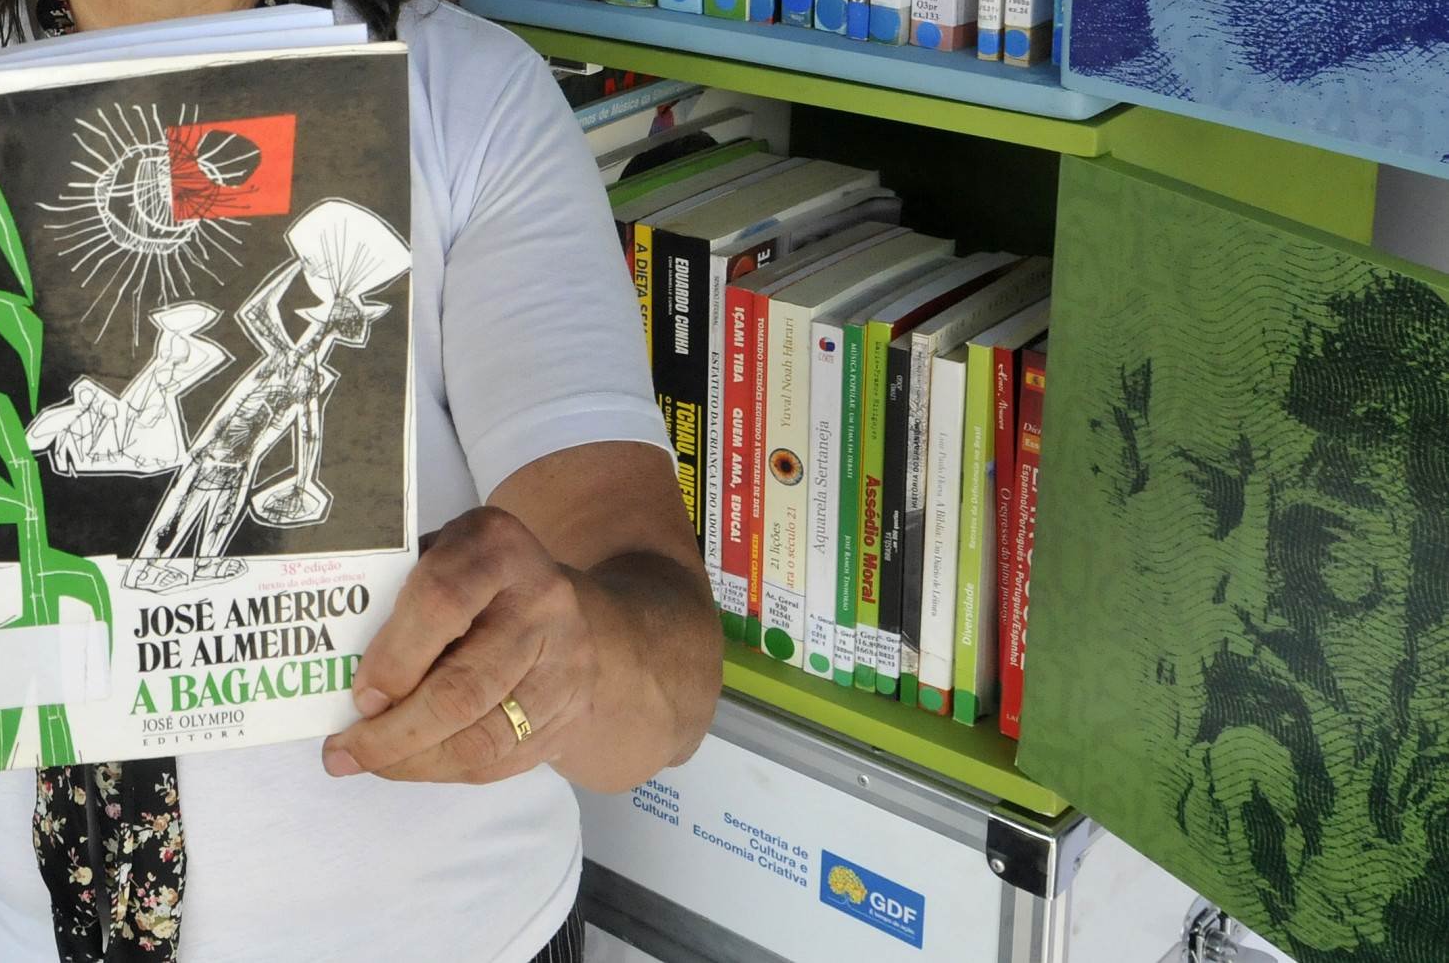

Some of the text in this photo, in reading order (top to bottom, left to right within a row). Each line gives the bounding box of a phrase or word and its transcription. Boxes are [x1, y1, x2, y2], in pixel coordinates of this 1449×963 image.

[635, 242, 648, 299] A DIETA
[674, 257, 690, 355] EDUARDO CUNHA
[755, 318, 764, 360] TOMANDO
[710, 351, 720, 410] ESTATUTO
[781, 317, 795, 428] Yuval Noah Harari
[710, 411, 719, 425] DA
[728, 306, 745, 543] IÇAMI TIBA QUEM AMA, EDUCA!
[753, 402, 762, 440] SEGUNDO
[708, 425, 718, 480] CRIANÇA
[752, 448, 761, 485] VONTADE
[708, 492, 718, 508] DO
[752, 486, 760, 497] DE
[812, 420, 832, 555] Aquarela Sertaneja
[751, 498, 760, 518] DEUS
[787, 507, 797, 519] 21
[1016, 463, 1031, 563] Espanhol/Português
[769, 522, 781, 569] 21 lições
[786, 526, 797, 557] século
[862, 474, 881, 605] Assédio Moral
[786, 571, 795, 588] ara
[133, 584, 370, 639] JOSÉ AMÉRICO
[961, 583, 975, 646] Diversidade
[1009, 569, 1025, 666] Português/Espanhol
[138, 624, 337, 673] DE ALMEIDA
[130, 678, 158, 716] A
[142, 709, 245, 733] JOSÉ OLYMPIO
[142, 729, 246, 747] EDITORA
[630, 786, 680, 813] rimônio
[646, 779, 680, 800] etaria
[632, 796, 680, 827] Cultural
[692, 824, 808, 887] Economia Criativa
[723, 811, 809, 860] Secretaria de
[749, 838, 808, 874] Cultura e
[869, 891, 918, 925] GDF
